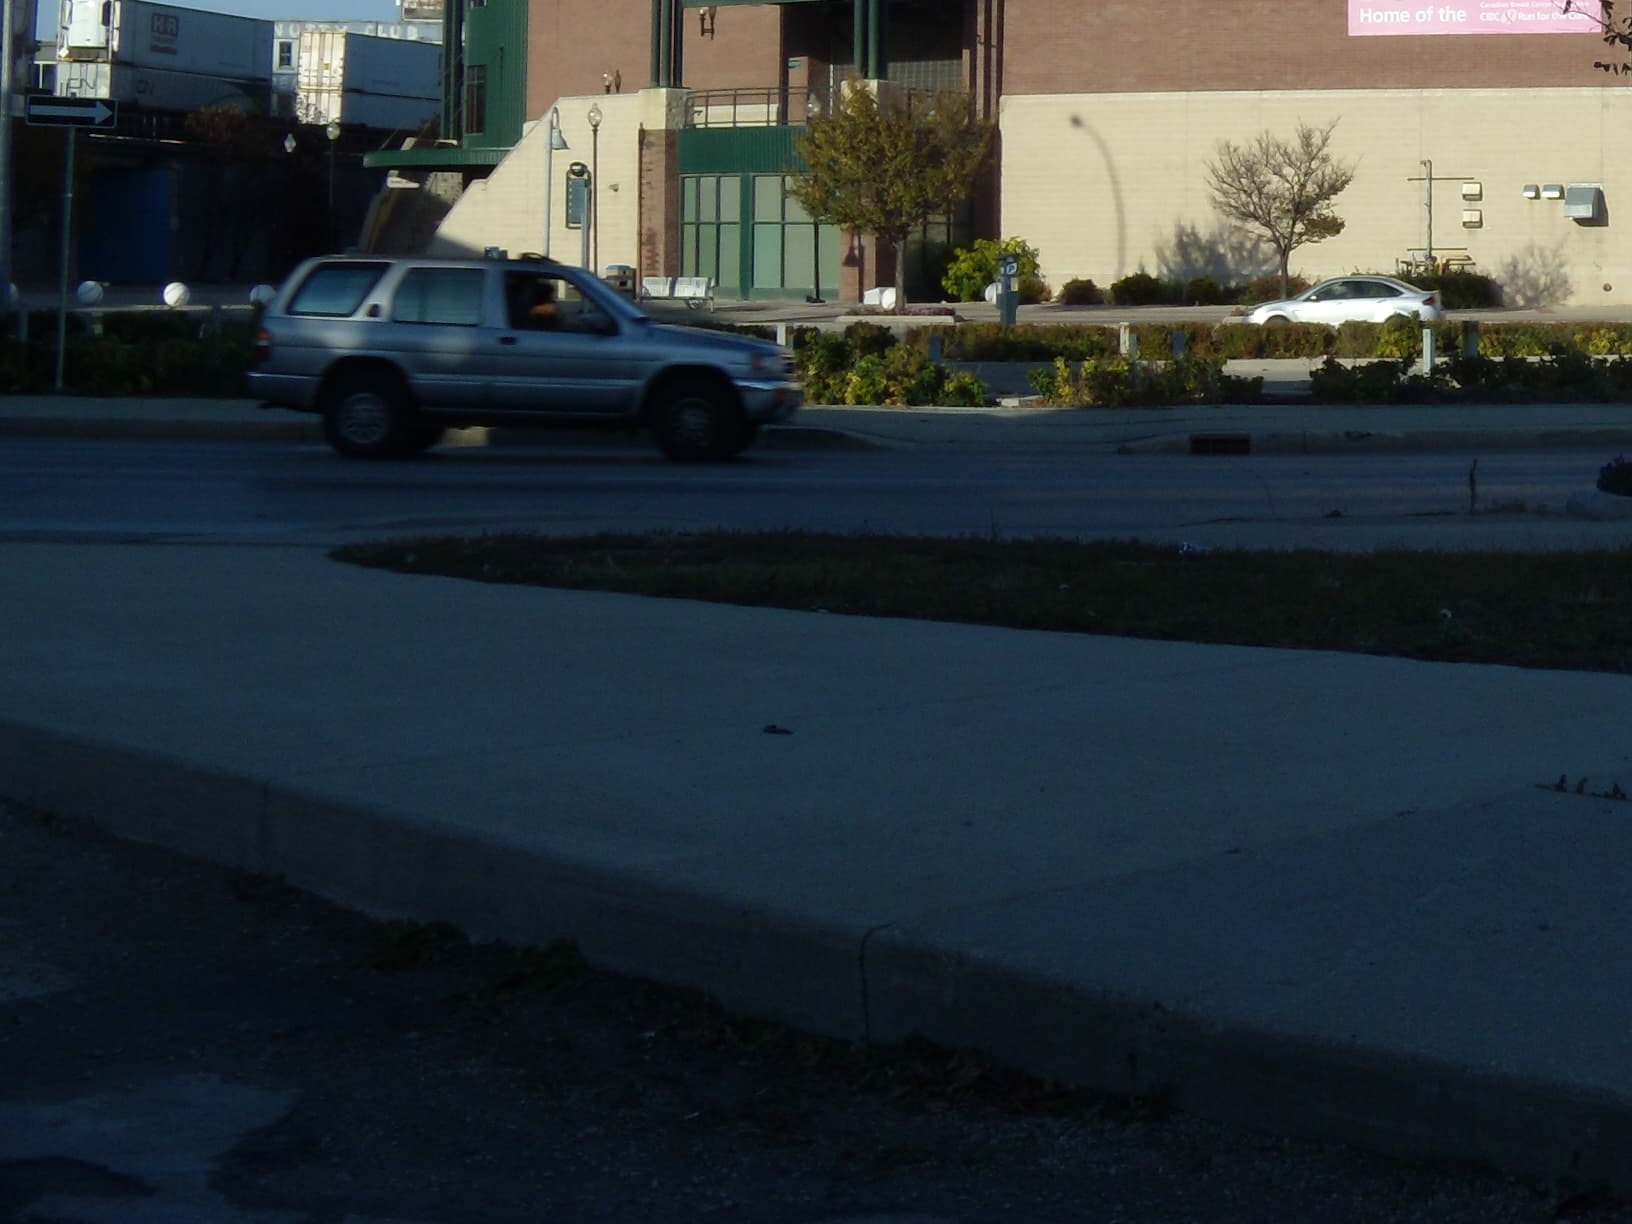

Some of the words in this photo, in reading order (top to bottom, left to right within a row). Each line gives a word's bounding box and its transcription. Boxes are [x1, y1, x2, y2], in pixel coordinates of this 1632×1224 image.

[1359, 7, 1411, 24] Home
[1415, 5, 1434, 23] of
[1438, 5, 1467, 23] the
